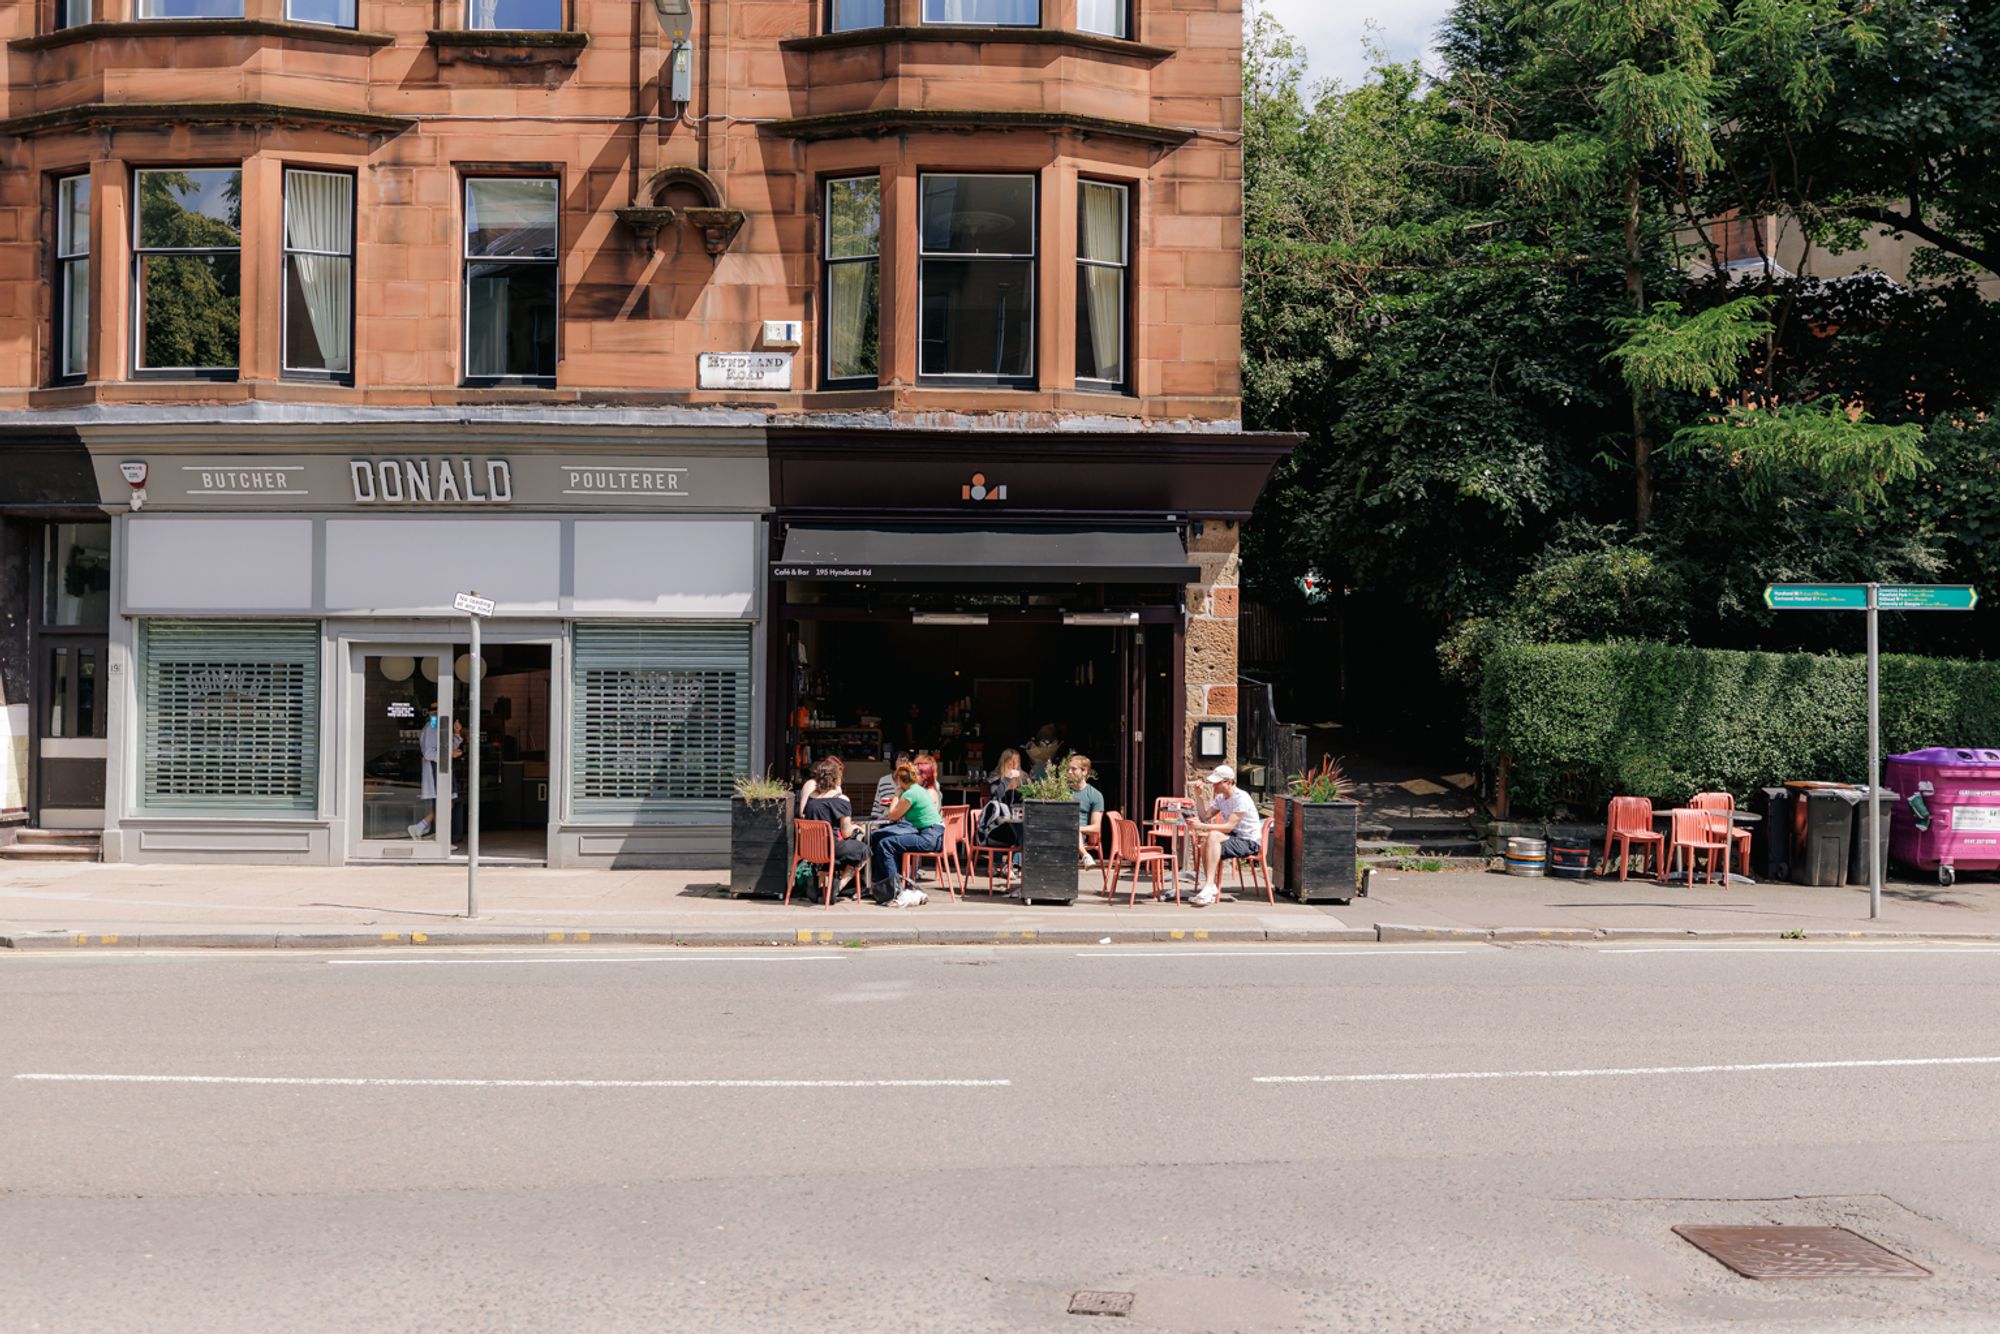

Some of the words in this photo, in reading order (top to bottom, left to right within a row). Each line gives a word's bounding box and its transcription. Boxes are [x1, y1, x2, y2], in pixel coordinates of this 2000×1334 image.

[726, 369, 765, 381] ROAD
[202, 472, 288, 489] BUTCHER
[349, 460, 512, 502] DONALD
[570, 472, 679, 490] POULTERER
[774, 568, 791, 576] Café
[829, 569, 861, 577] Hyndland
